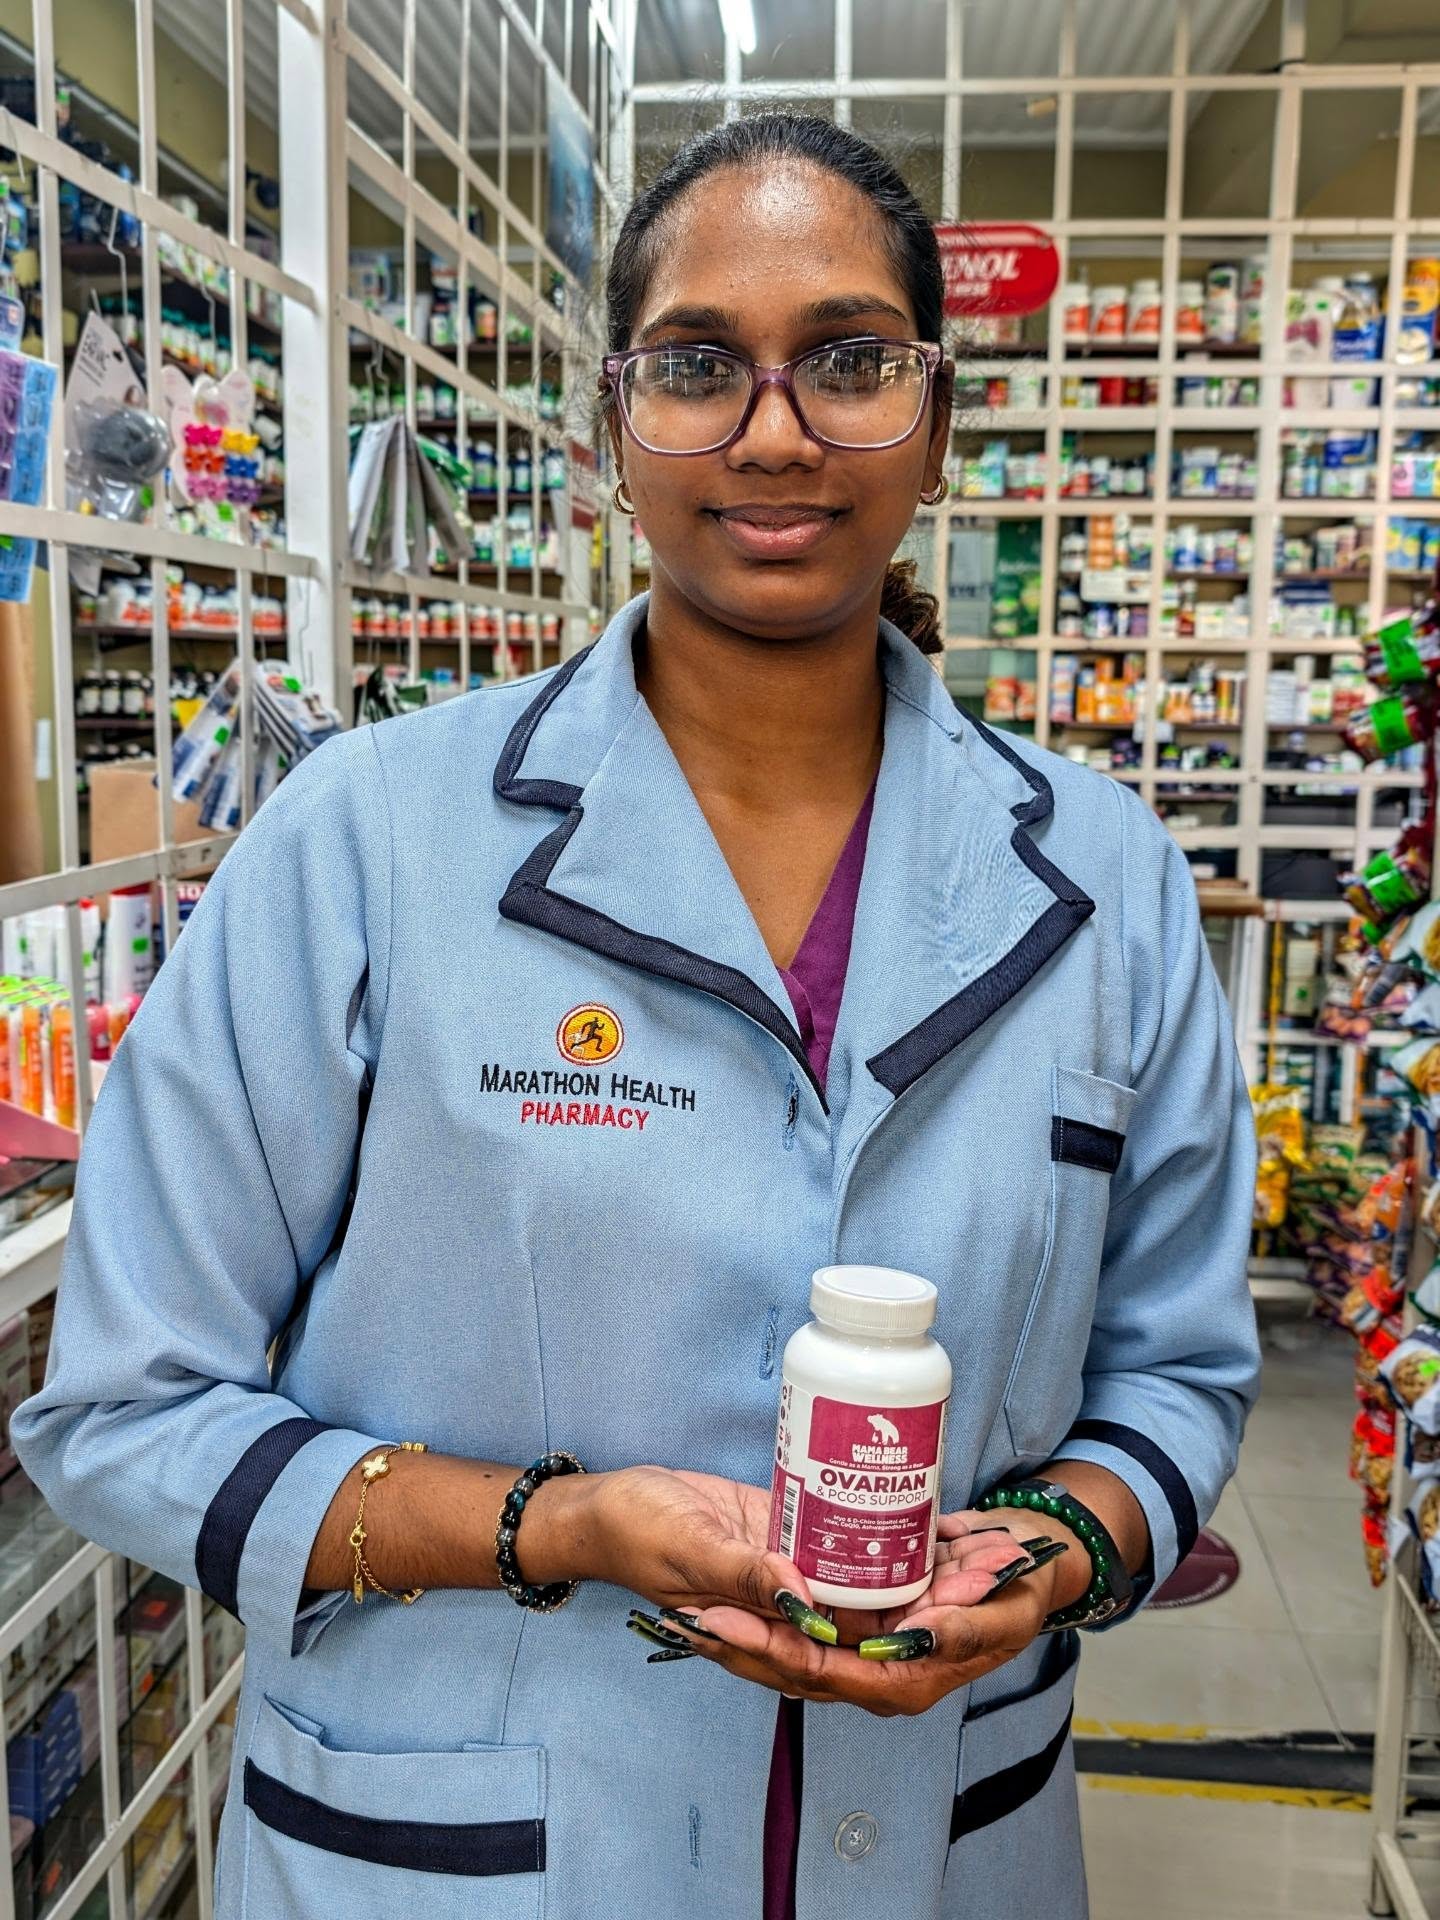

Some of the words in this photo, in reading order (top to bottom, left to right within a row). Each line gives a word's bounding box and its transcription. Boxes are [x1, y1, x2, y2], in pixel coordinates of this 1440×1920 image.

[480, 1063, 600, 1097] MARATHON
[611, 1073, 696, 1111] HEALTH
[521, 1100, 650, 1131] PHARMACY
[852, 1444, 882, 1455] MAMA
[883, 1446, 908, 1455] BEAR
[852, 1452, 908, 1465] WELLNESS
[820, 1468, 927, 1493] OVARIAN
[816, 1486, 824, 1497] &
[828, 1488, 866, 1504] PCOS
[869, 1490, 928, 1506] SUPPORT
[818, 1558, 840, 1568] NATURAL
